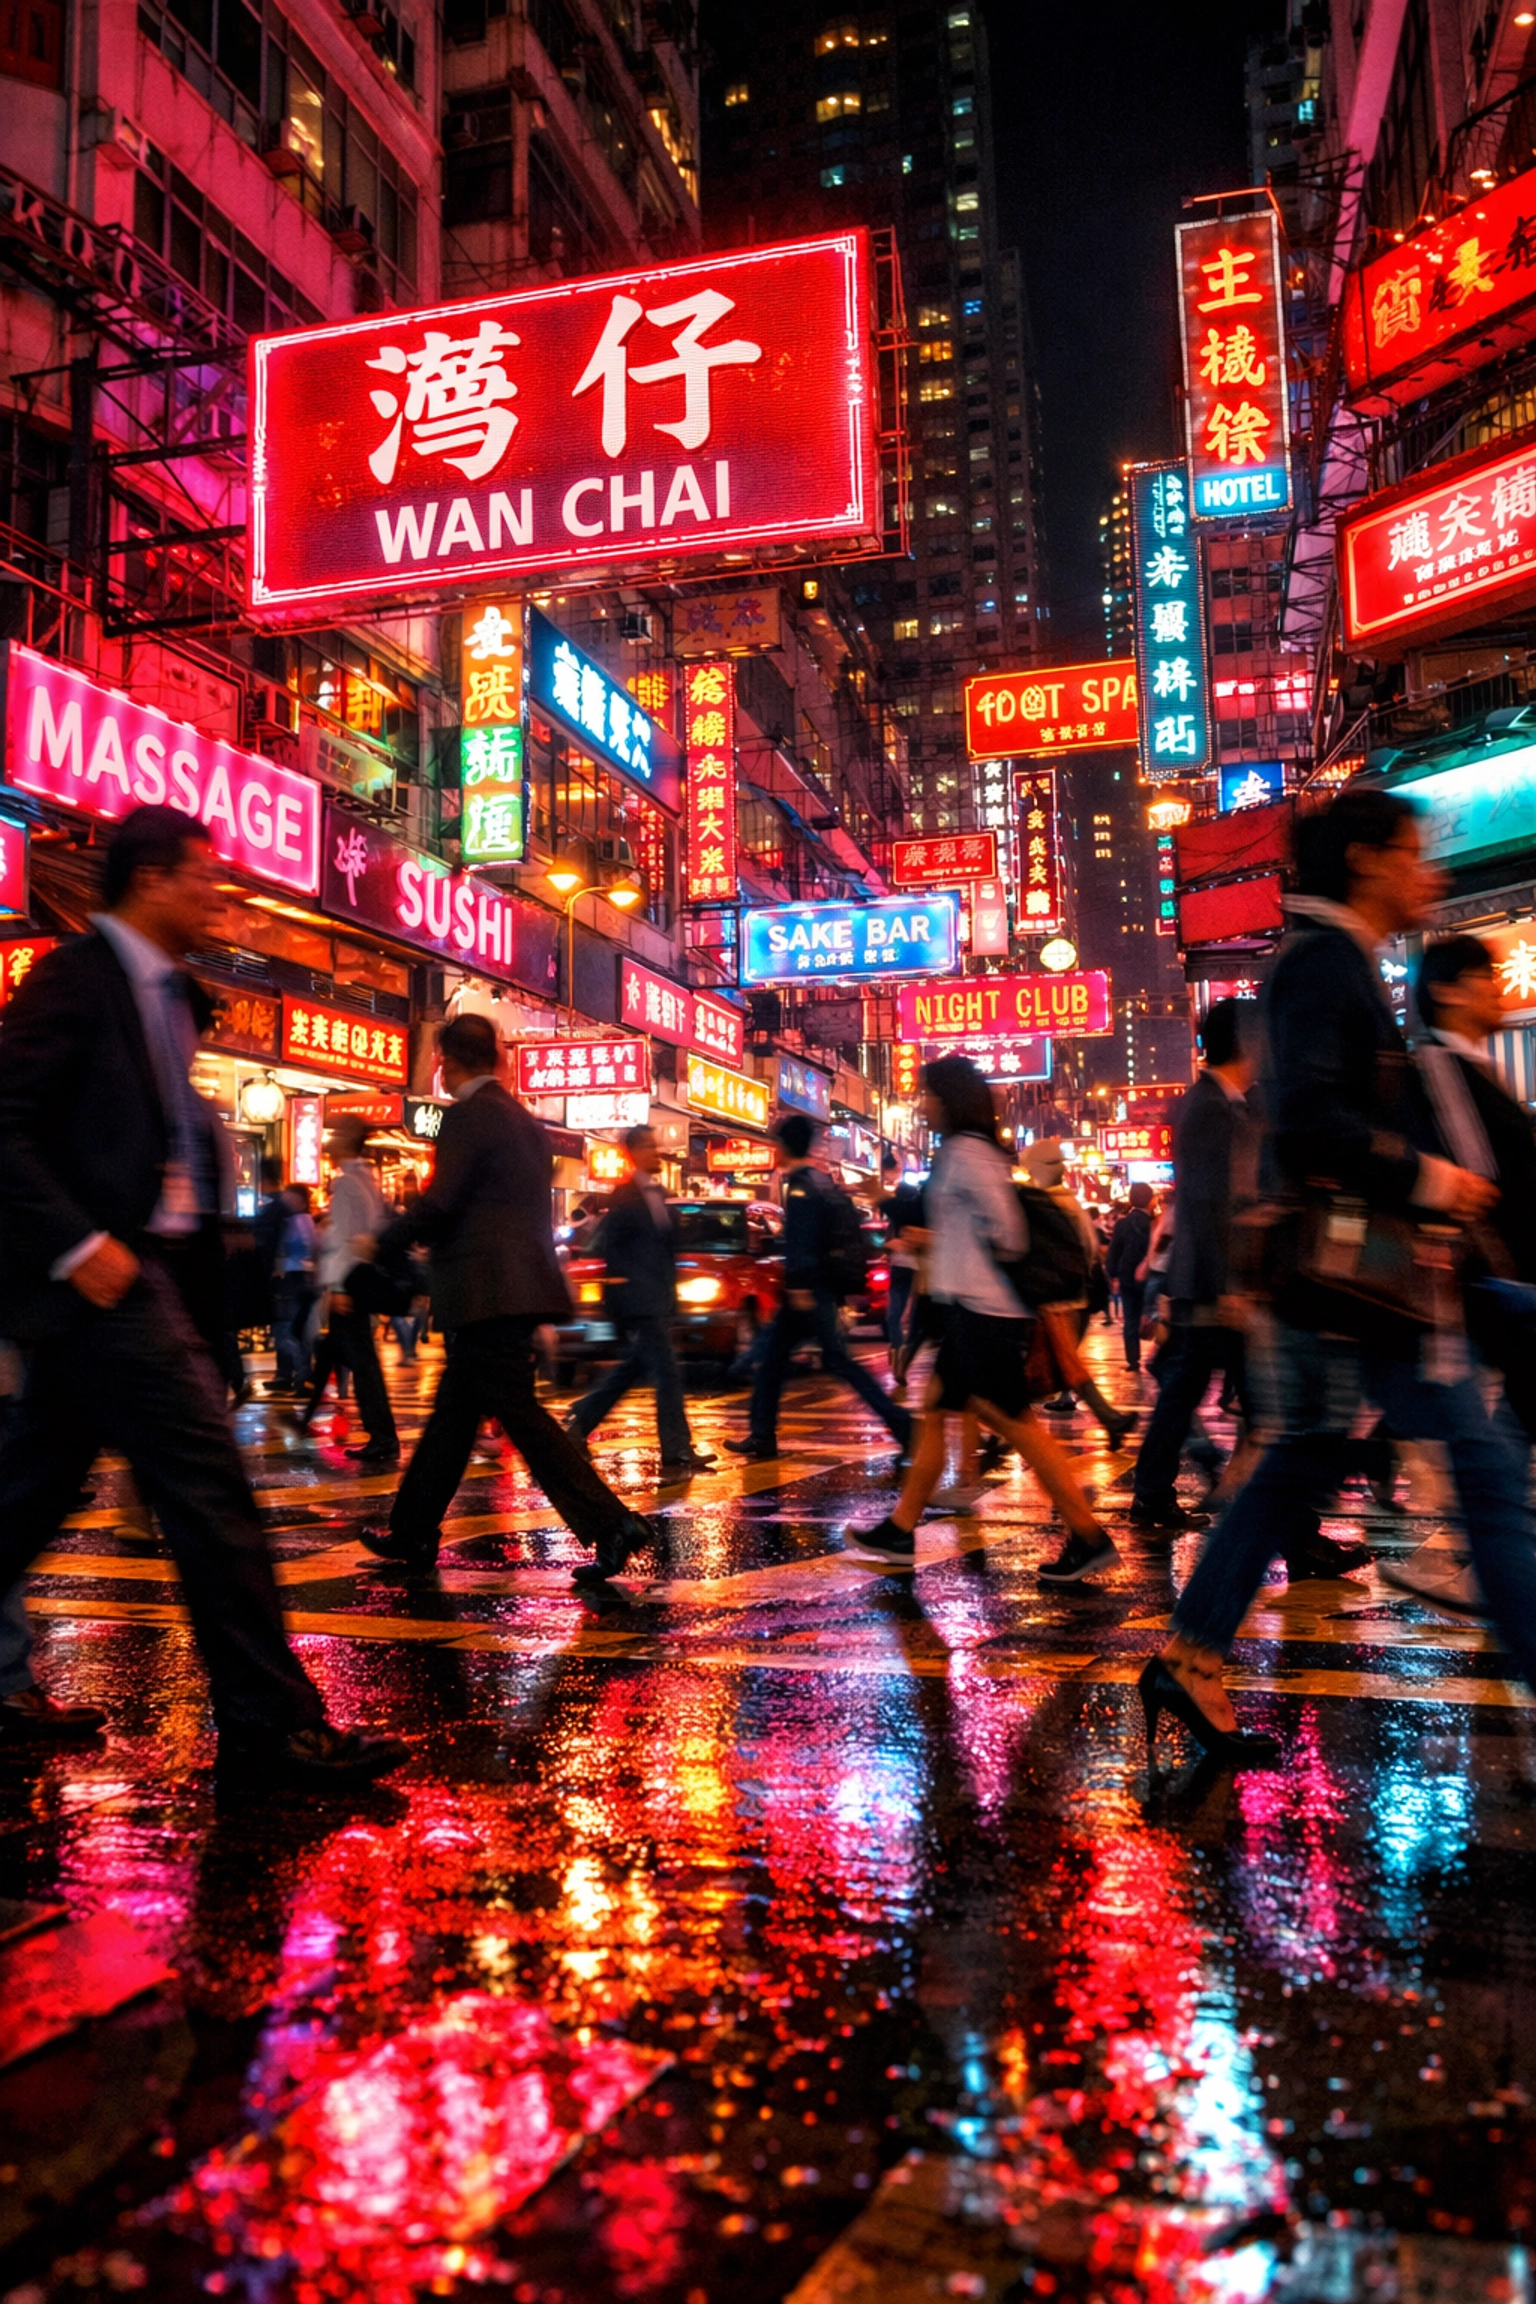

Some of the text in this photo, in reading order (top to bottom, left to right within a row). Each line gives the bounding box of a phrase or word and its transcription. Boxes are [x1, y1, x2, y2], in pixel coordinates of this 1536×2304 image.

[1203, 473, 1281, 507] HOTEL
[374, 460, 731, 565] WAN CHAI
[1082, 675, 1139, 714] SPA
[28, 685, 304, 863] MASSAGE
[397, 860, 513, 966] SUSHI
[768, 915, 932, 953] SAKE BAR
[915, 990, 1001, 1025] NIGHT
[1015, 984, 1089, 1018] CLUB
